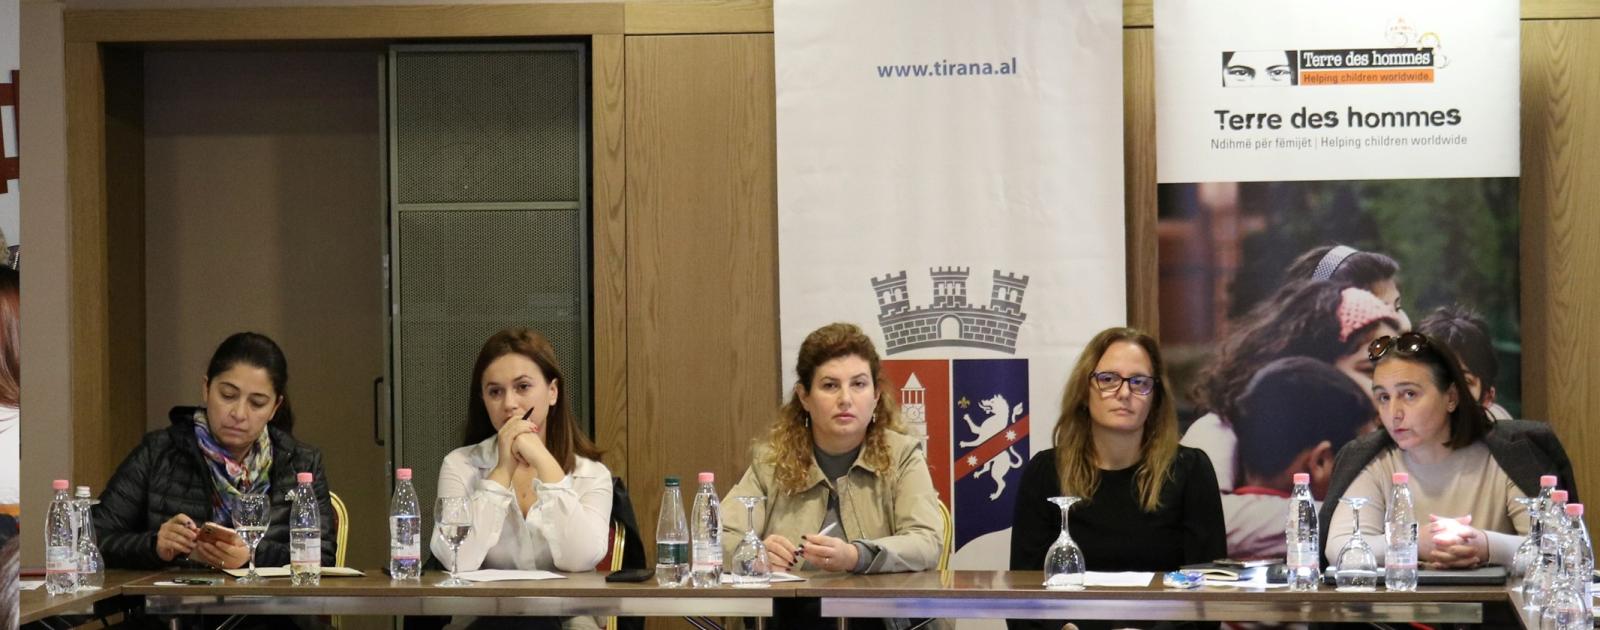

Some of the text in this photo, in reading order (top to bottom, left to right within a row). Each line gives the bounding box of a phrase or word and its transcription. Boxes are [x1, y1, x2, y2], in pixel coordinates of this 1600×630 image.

[877, 57, 1017, 77] www.tirana.al
[1303, 51, 1431, 67] Terre des hommes
[1303, 73, 1338, 84] Helping
[1340, 72, 1378, 82] children
[1214, 106, 1462, 130] Terre des hommes
[1210, 134, 1468, 150] Ndihmë për fëmijët Helping children worldwide
